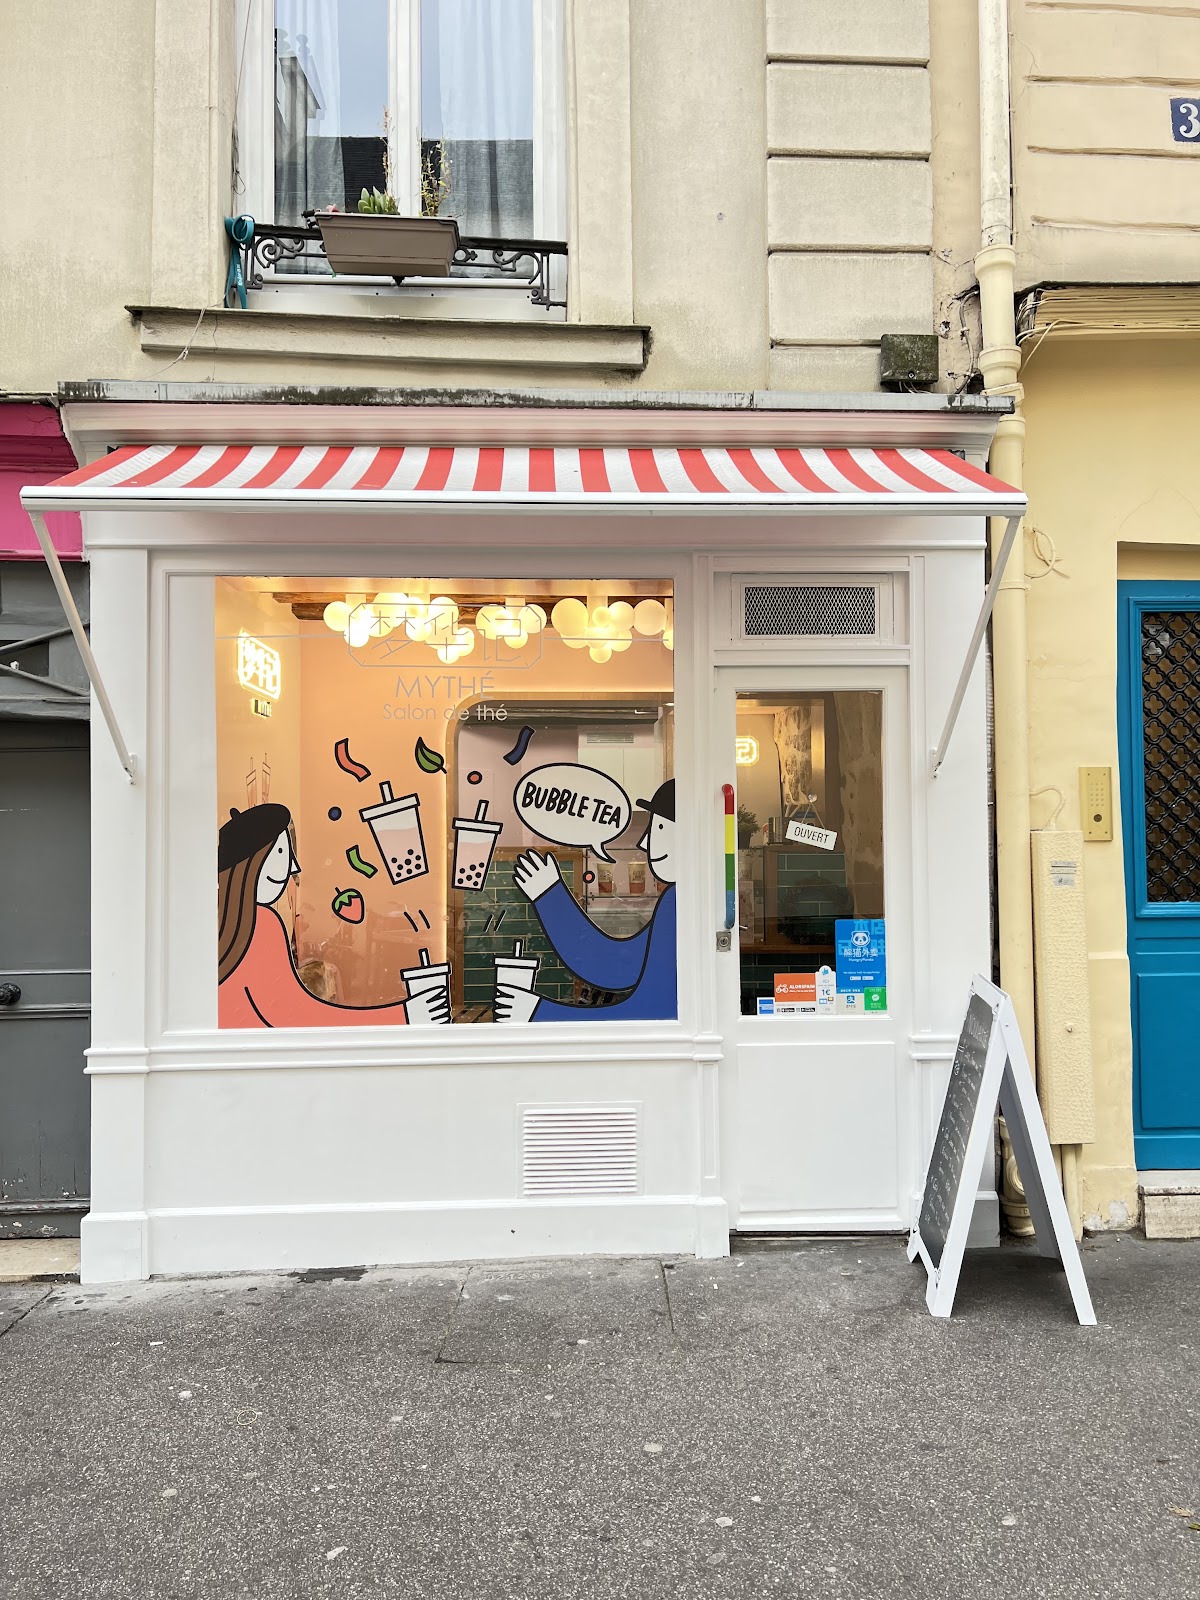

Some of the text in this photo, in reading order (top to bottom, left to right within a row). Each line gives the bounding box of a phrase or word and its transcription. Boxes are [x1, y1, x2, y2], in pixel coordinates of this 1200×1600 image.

[1179, 102, 1200, 138] 3
[395, 671, 495, 699] MYTHÉ
[383, 703, 508, 721] Salon de thé
[521, 781, 622, 829] BUBBLE TEA
[794, 826, 830, 844] OUVERT
[843, 948, 879, 958] 熊猫外卖
